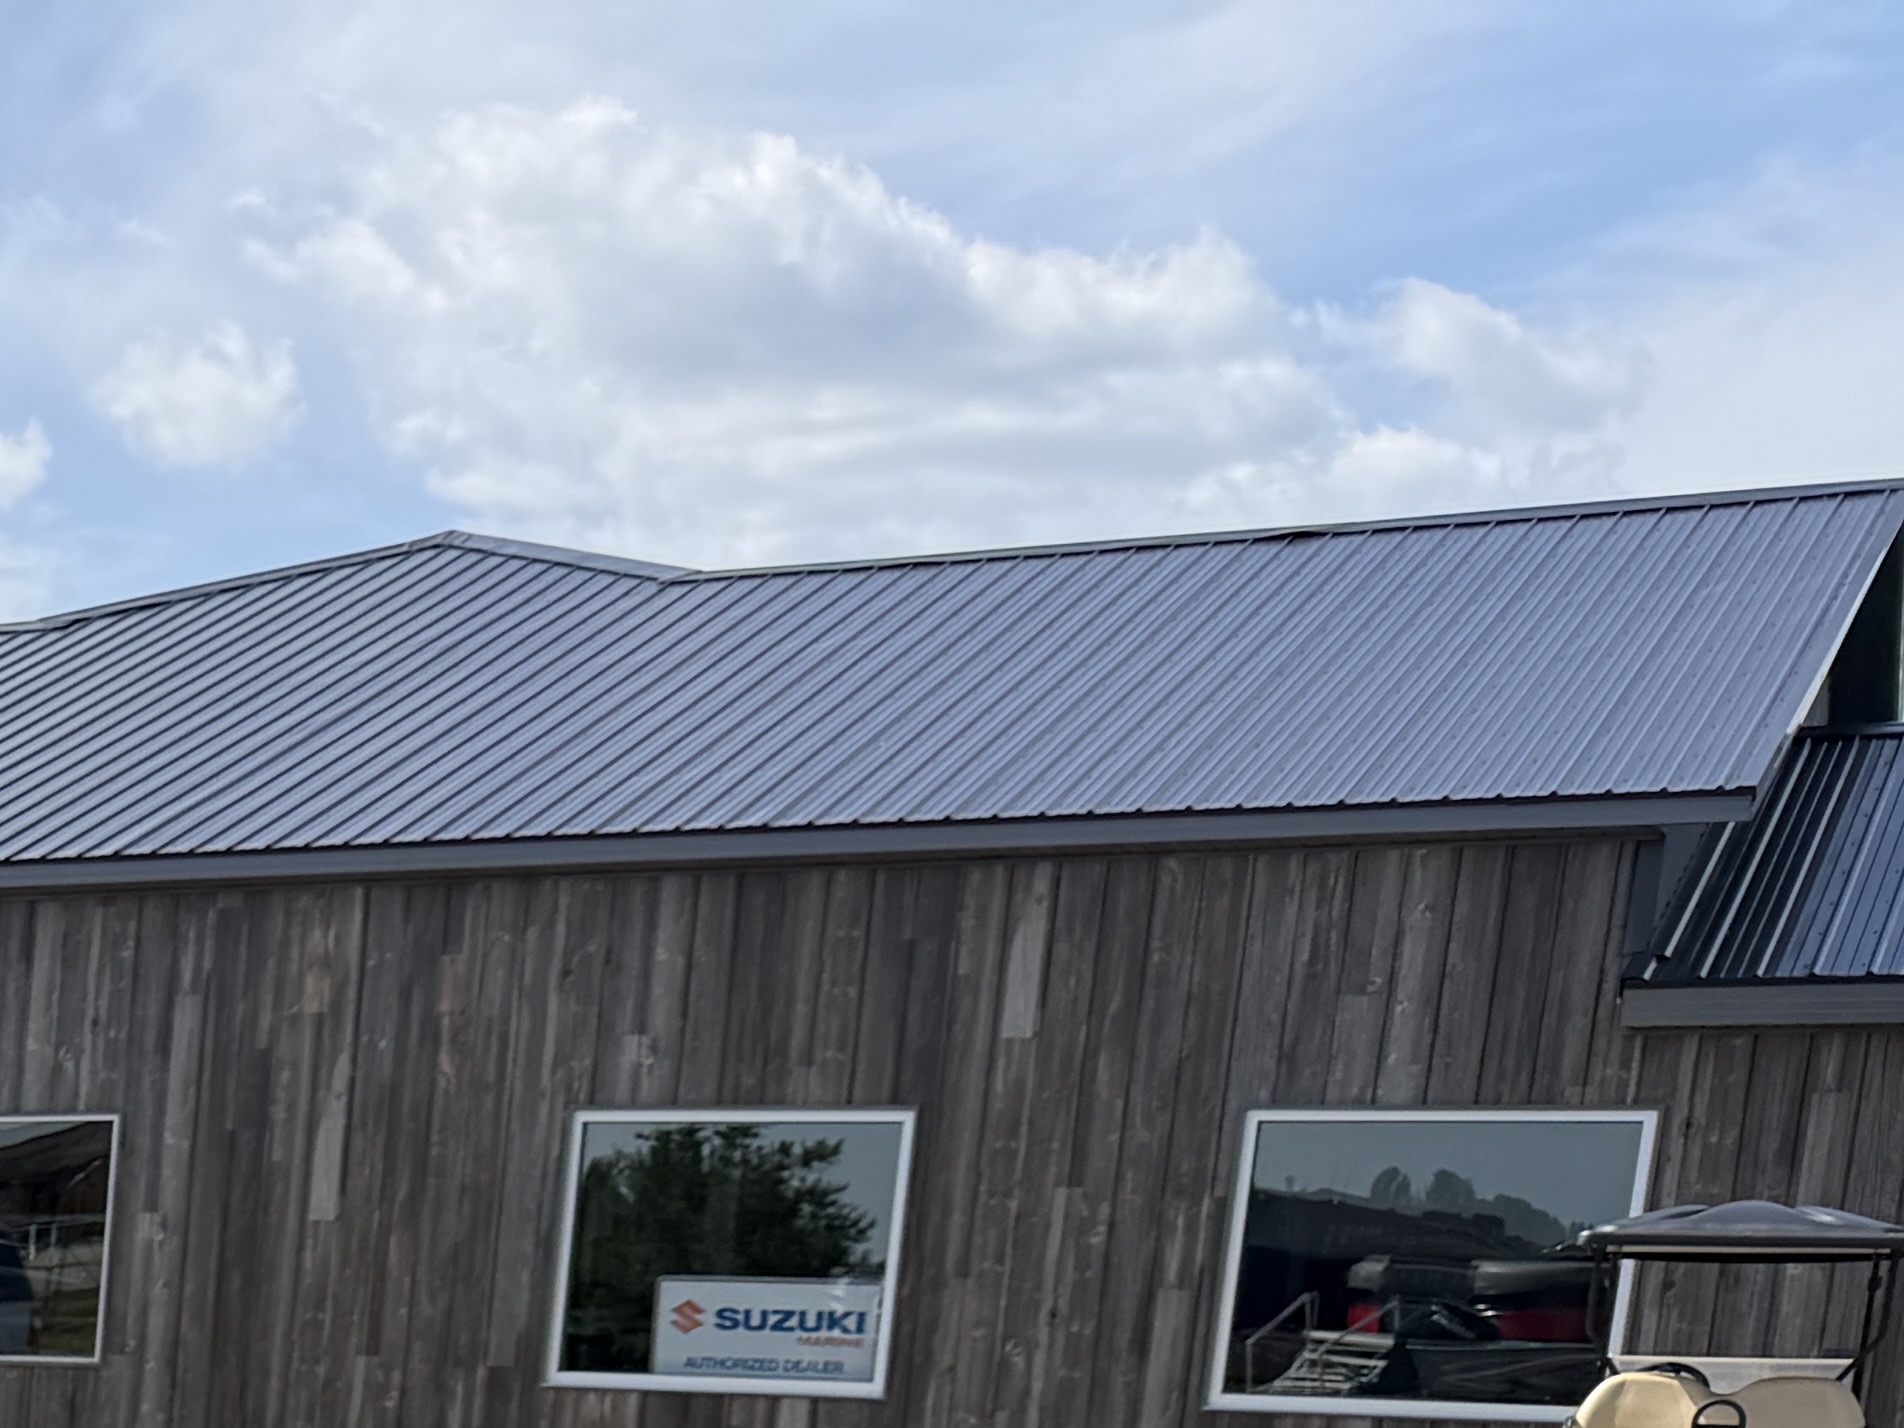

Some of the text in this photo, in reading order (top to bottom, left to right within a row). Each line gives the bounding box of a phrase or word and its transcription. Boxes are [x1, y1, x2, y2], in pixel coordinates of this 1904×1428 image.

[714, 1307, 868, 1335] SUZUKI
[796, 1335, 865, 1348] MARINE
[684, 1356, 845, 1375] AUTHORIZED DEALER
